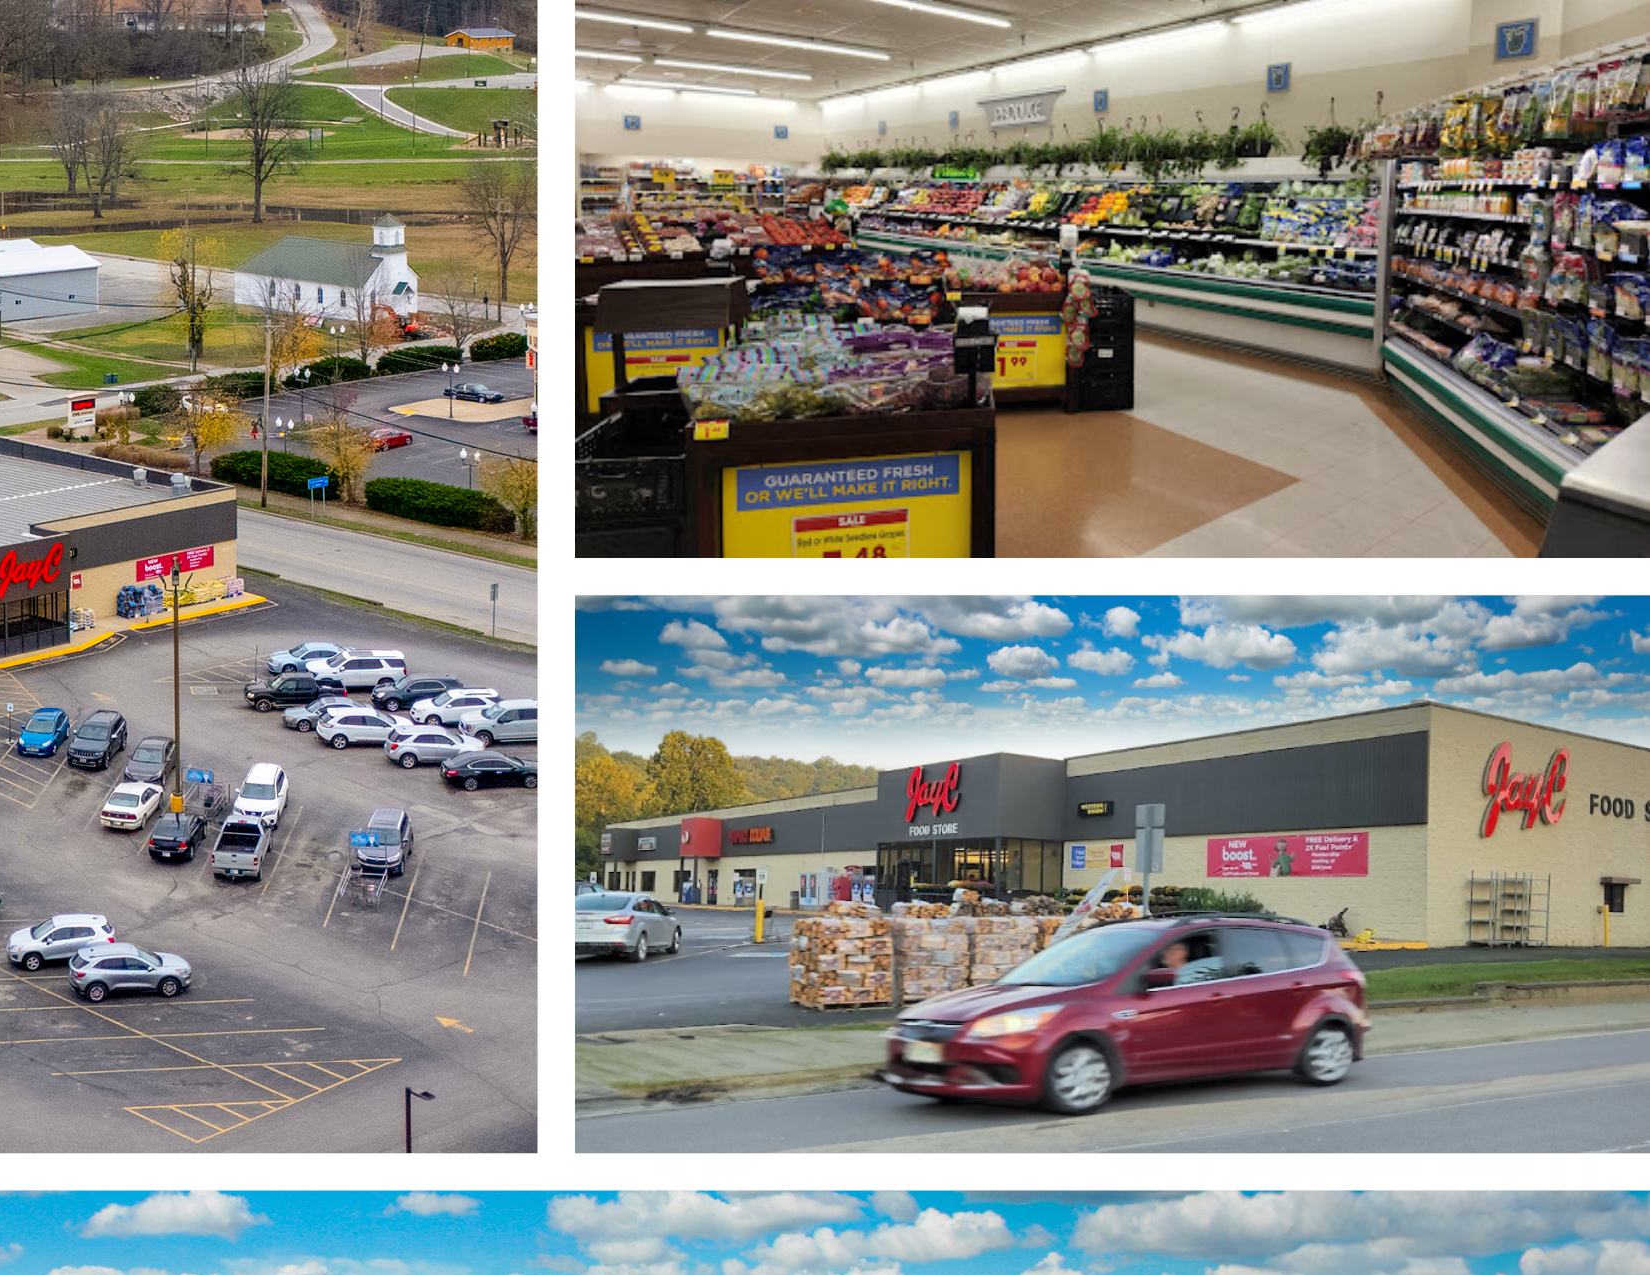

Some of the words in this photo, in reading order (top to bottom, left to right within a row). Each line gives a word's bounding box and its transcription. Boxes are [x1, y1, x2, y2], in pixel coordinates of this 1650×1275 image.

[765, 466, 878, 488] GUARANTEED
[882, 464, 934, 479] FRESH
[745, 490, 770, 504] OR
[775, 485, 828, 502] WE'LL
[832, 482, 877, 497] MAKE
[882, 480, 896, 492] IT
[901, 476, 952, 491] RIGHT.
[838, 515, 866, 527] SALE
[905, 761, 959, 823] JayC
[1480, 741, 1570, 838] JayC
[1589, 793, 1635, 819] FOOD
[909, 826, 930, 837] FOOD
[932, 823, 958, 835] STORE
[1305, 836, 1322, 844] FREE
[1324, 835, 1350, 844] Delivery
[1228, 840, 1247, 849] NEW
